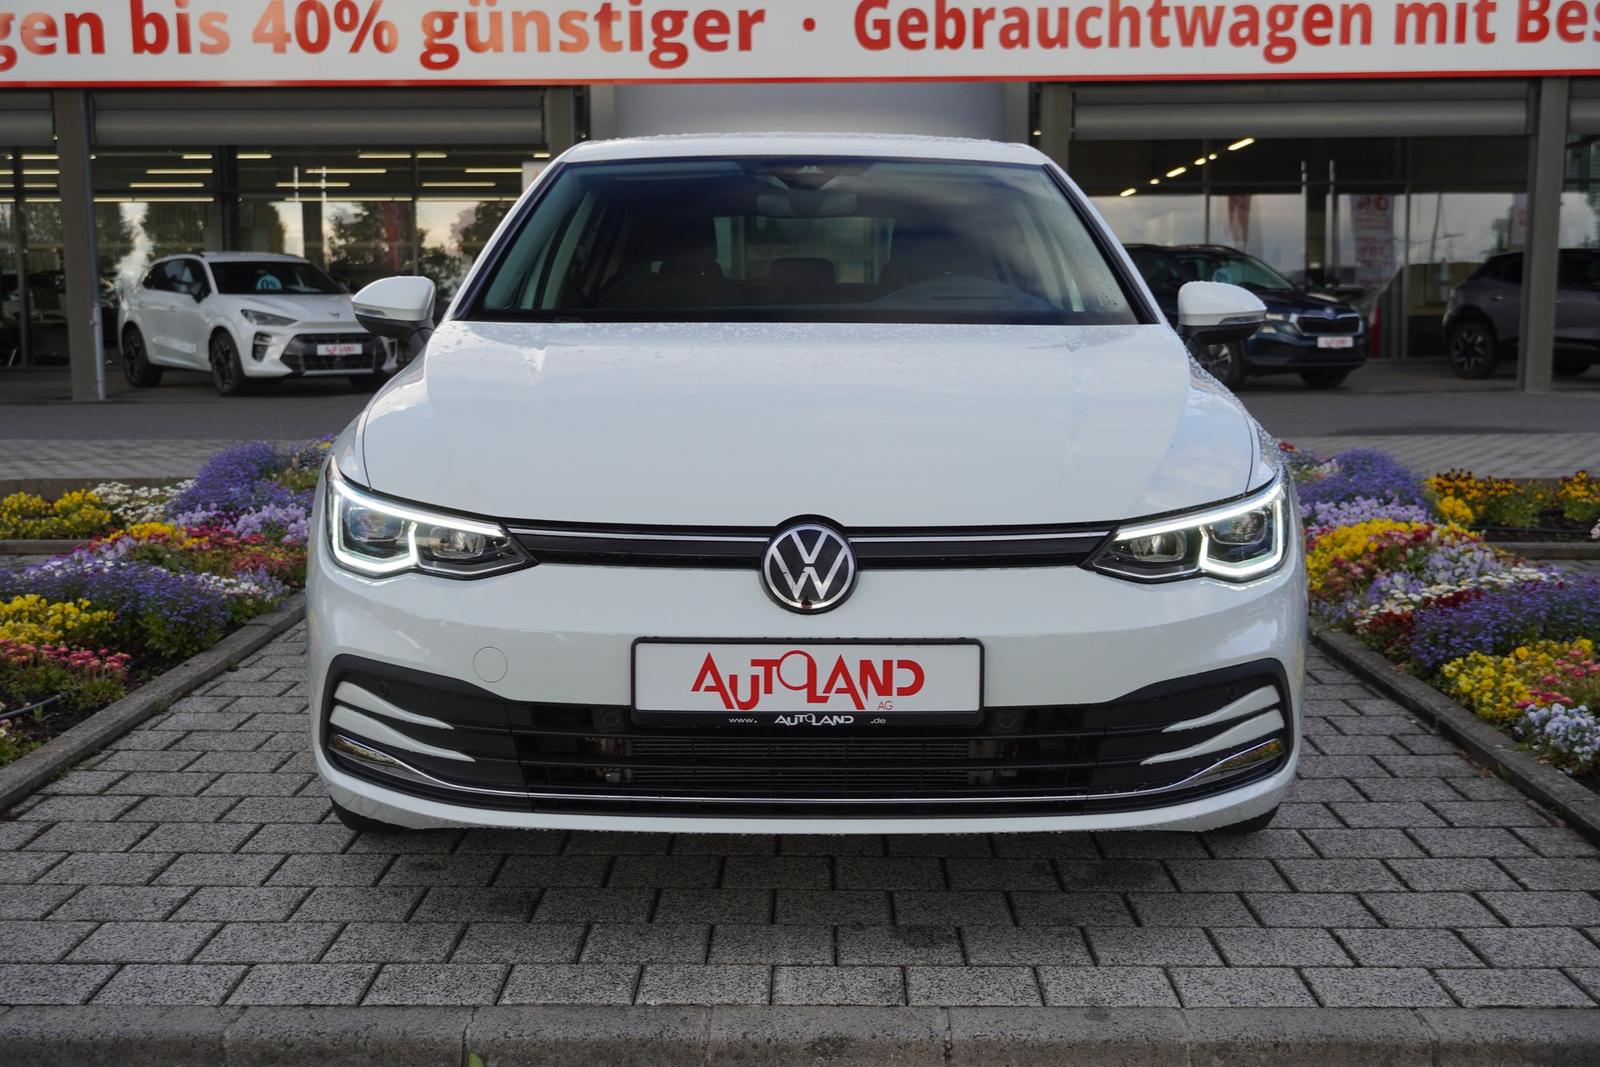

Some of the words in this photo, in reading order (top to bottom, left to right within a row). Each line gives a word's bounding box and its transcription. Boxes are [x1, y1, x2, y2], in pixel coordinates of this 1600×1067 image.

[130, 0, 230, 55] bis
[252, 0, 399, 54] 40%
[419, 0, 766, 71] günstiger
[853, 0, 1374, 65] Gebrauchtwagen
[1394, 0, 1498, 46] mit
[690, 649, 925, 711] AUTOLAND
[774, 713, 855, 726] AUTOLAND
[877, 700, 894, 711] AG
